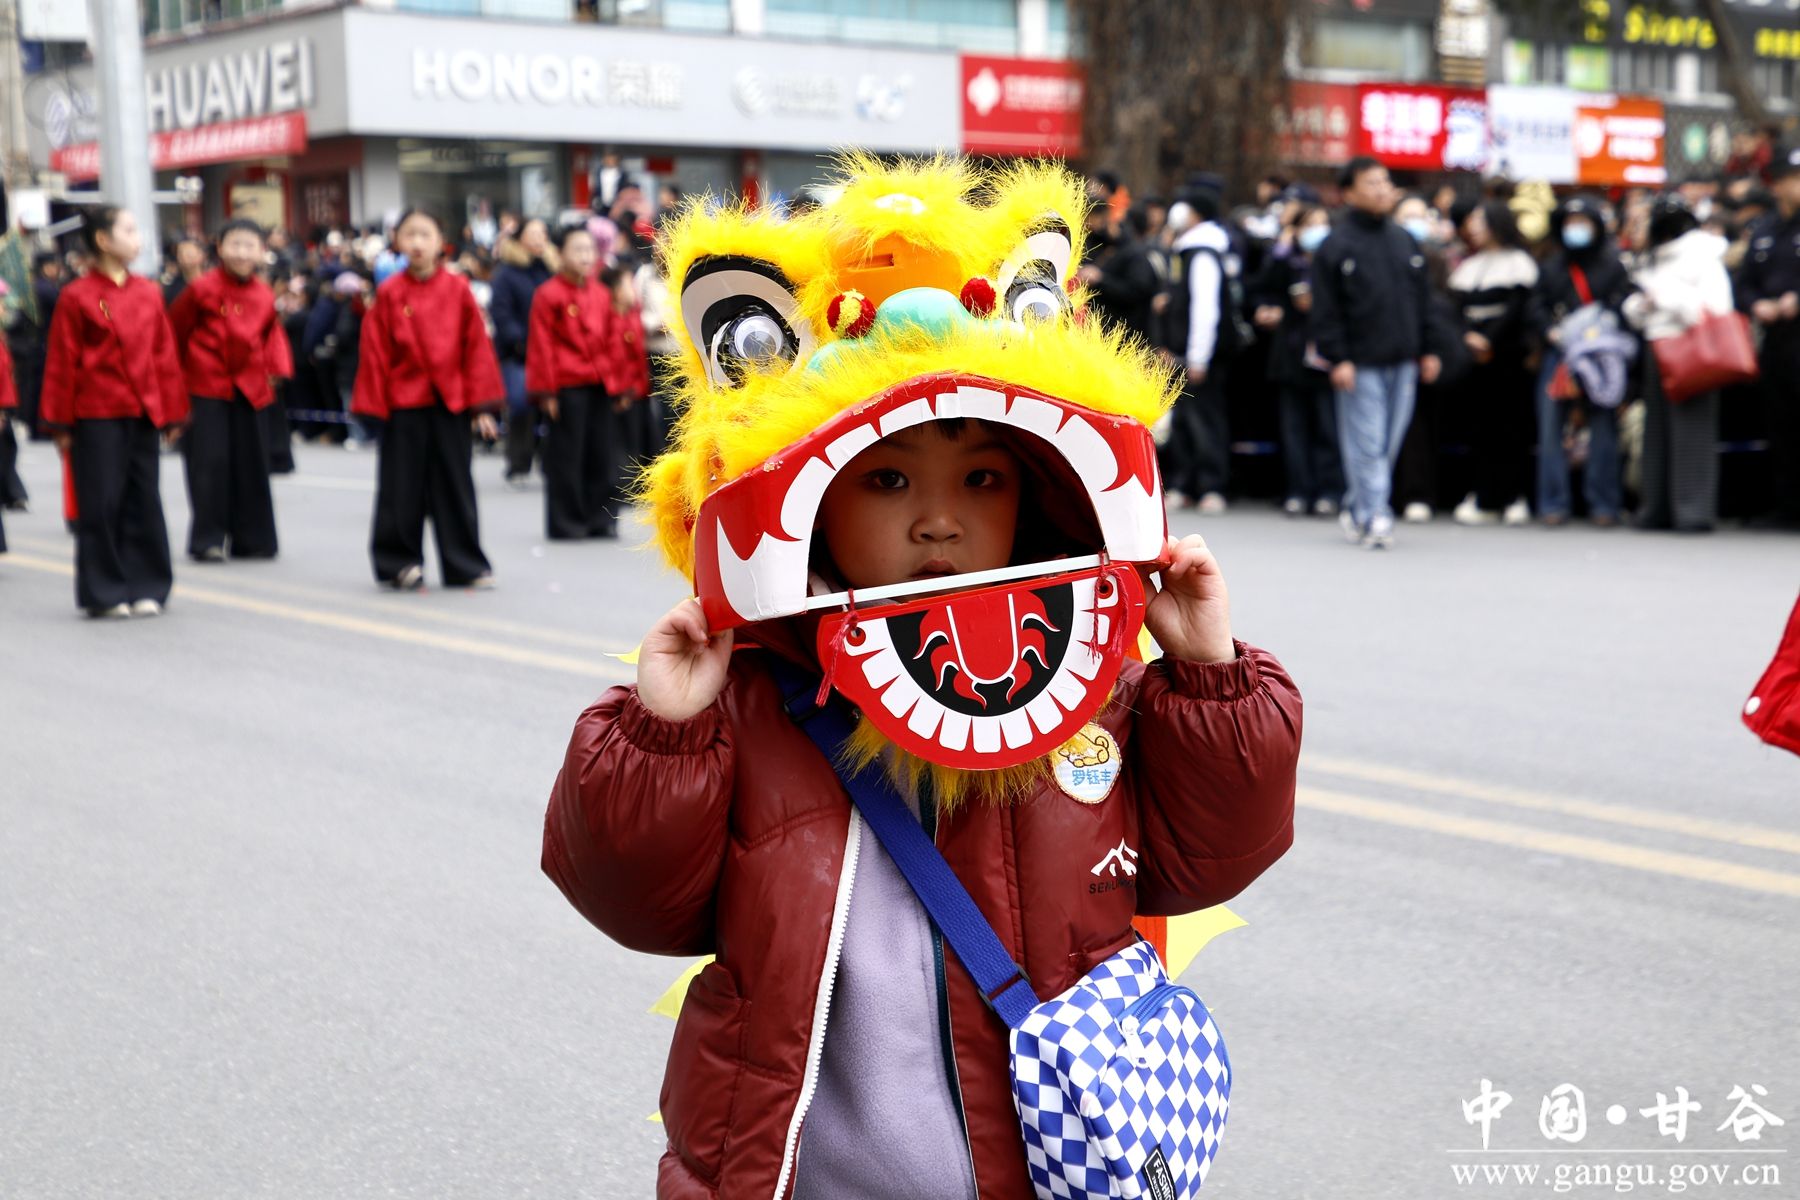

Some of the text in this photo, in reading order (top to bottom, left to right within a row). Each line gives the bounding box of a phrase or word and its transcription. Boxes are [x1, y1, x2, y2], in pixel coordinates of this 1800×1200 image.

[147, 37, 314, 131] HUAWEI
[412, 47, 604, 106] HONOR
[1071, 767, 1113, 786] 罗钰丰
